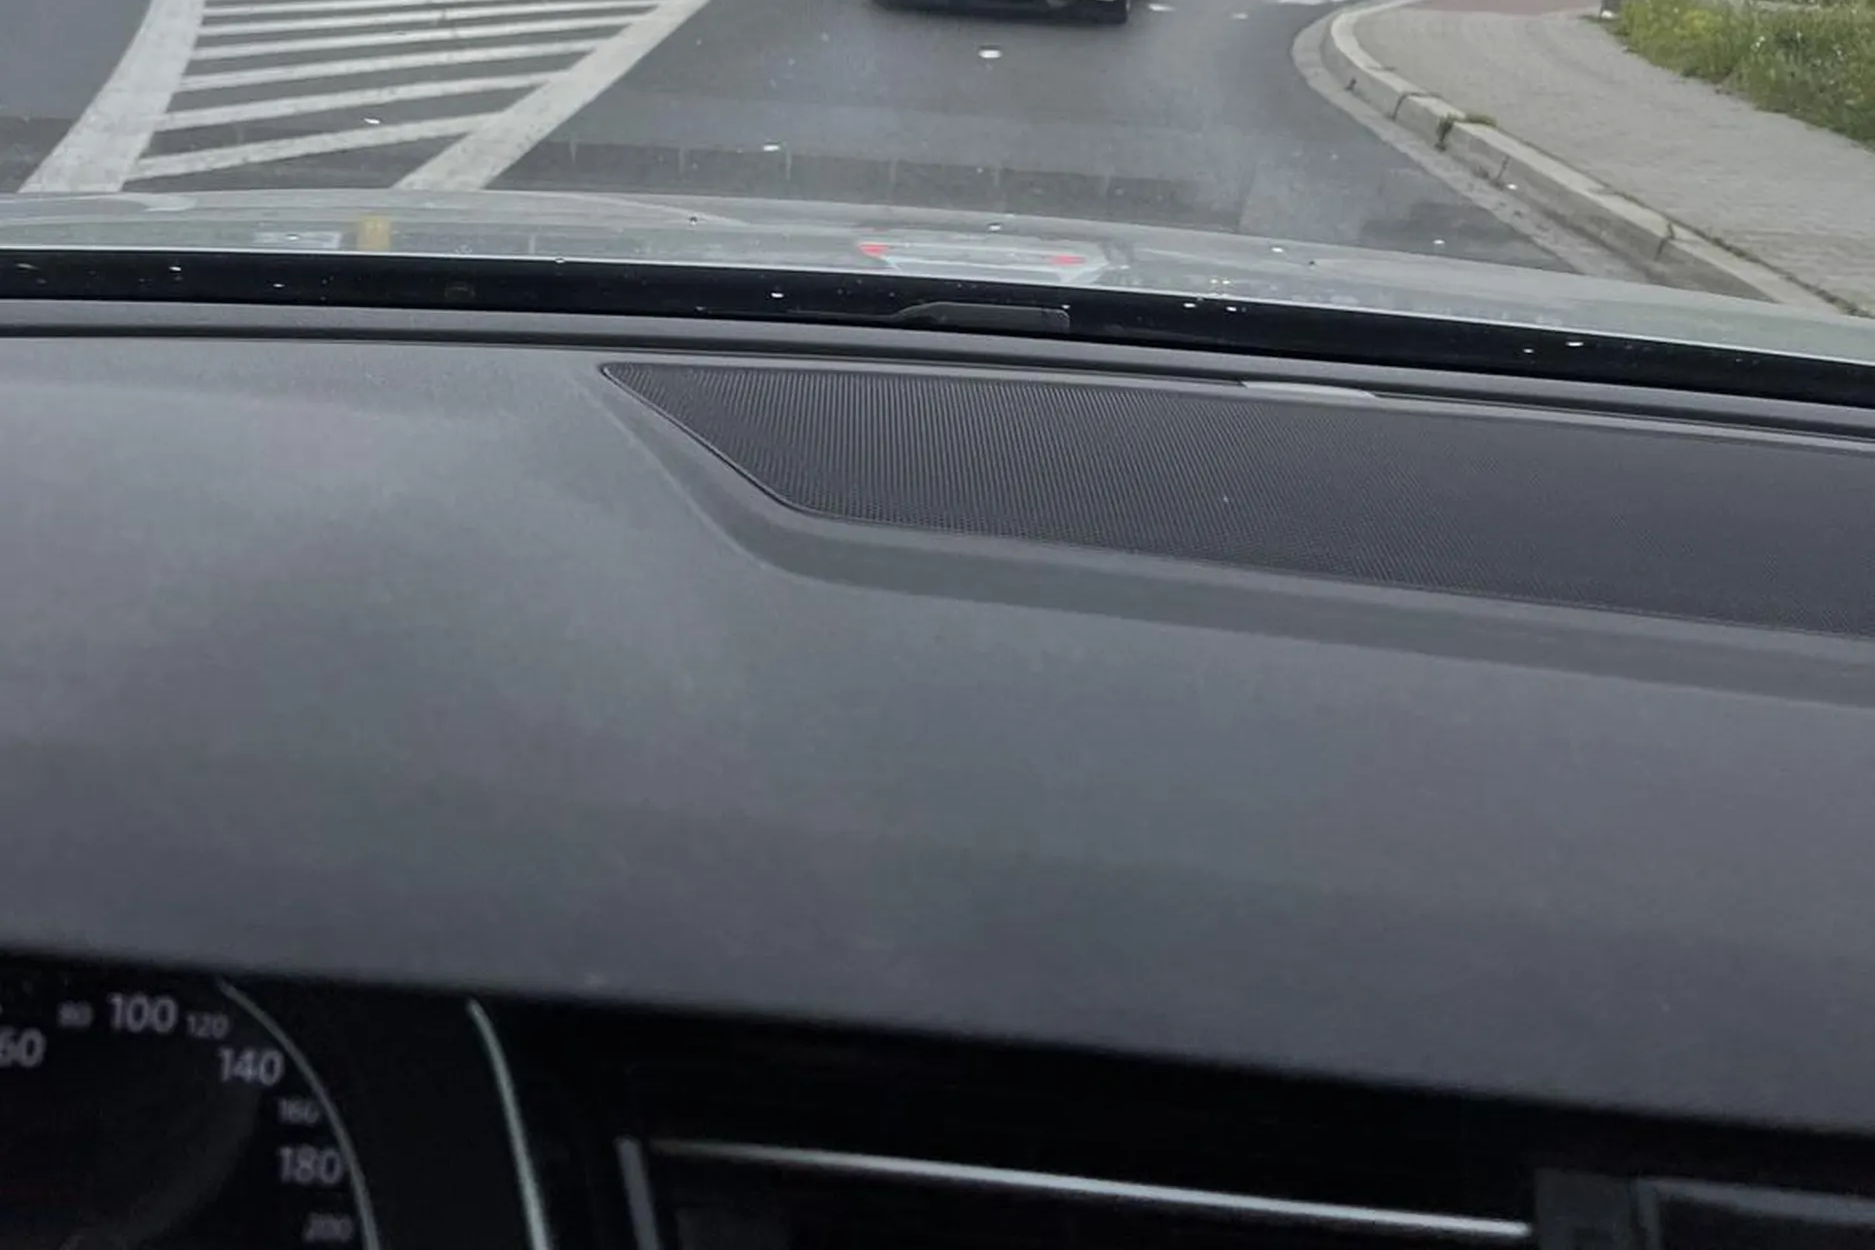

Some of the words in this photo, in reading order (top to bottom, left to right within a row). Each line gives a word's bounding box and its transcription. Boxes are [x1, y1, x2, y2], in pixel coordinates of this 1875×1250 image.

[109, 993, 178, 1034] 100
[187, 1012, 230, 1040] 120
[219, 1047, 284, 1086] 140
[278, 1146, 344, 1184] 180
